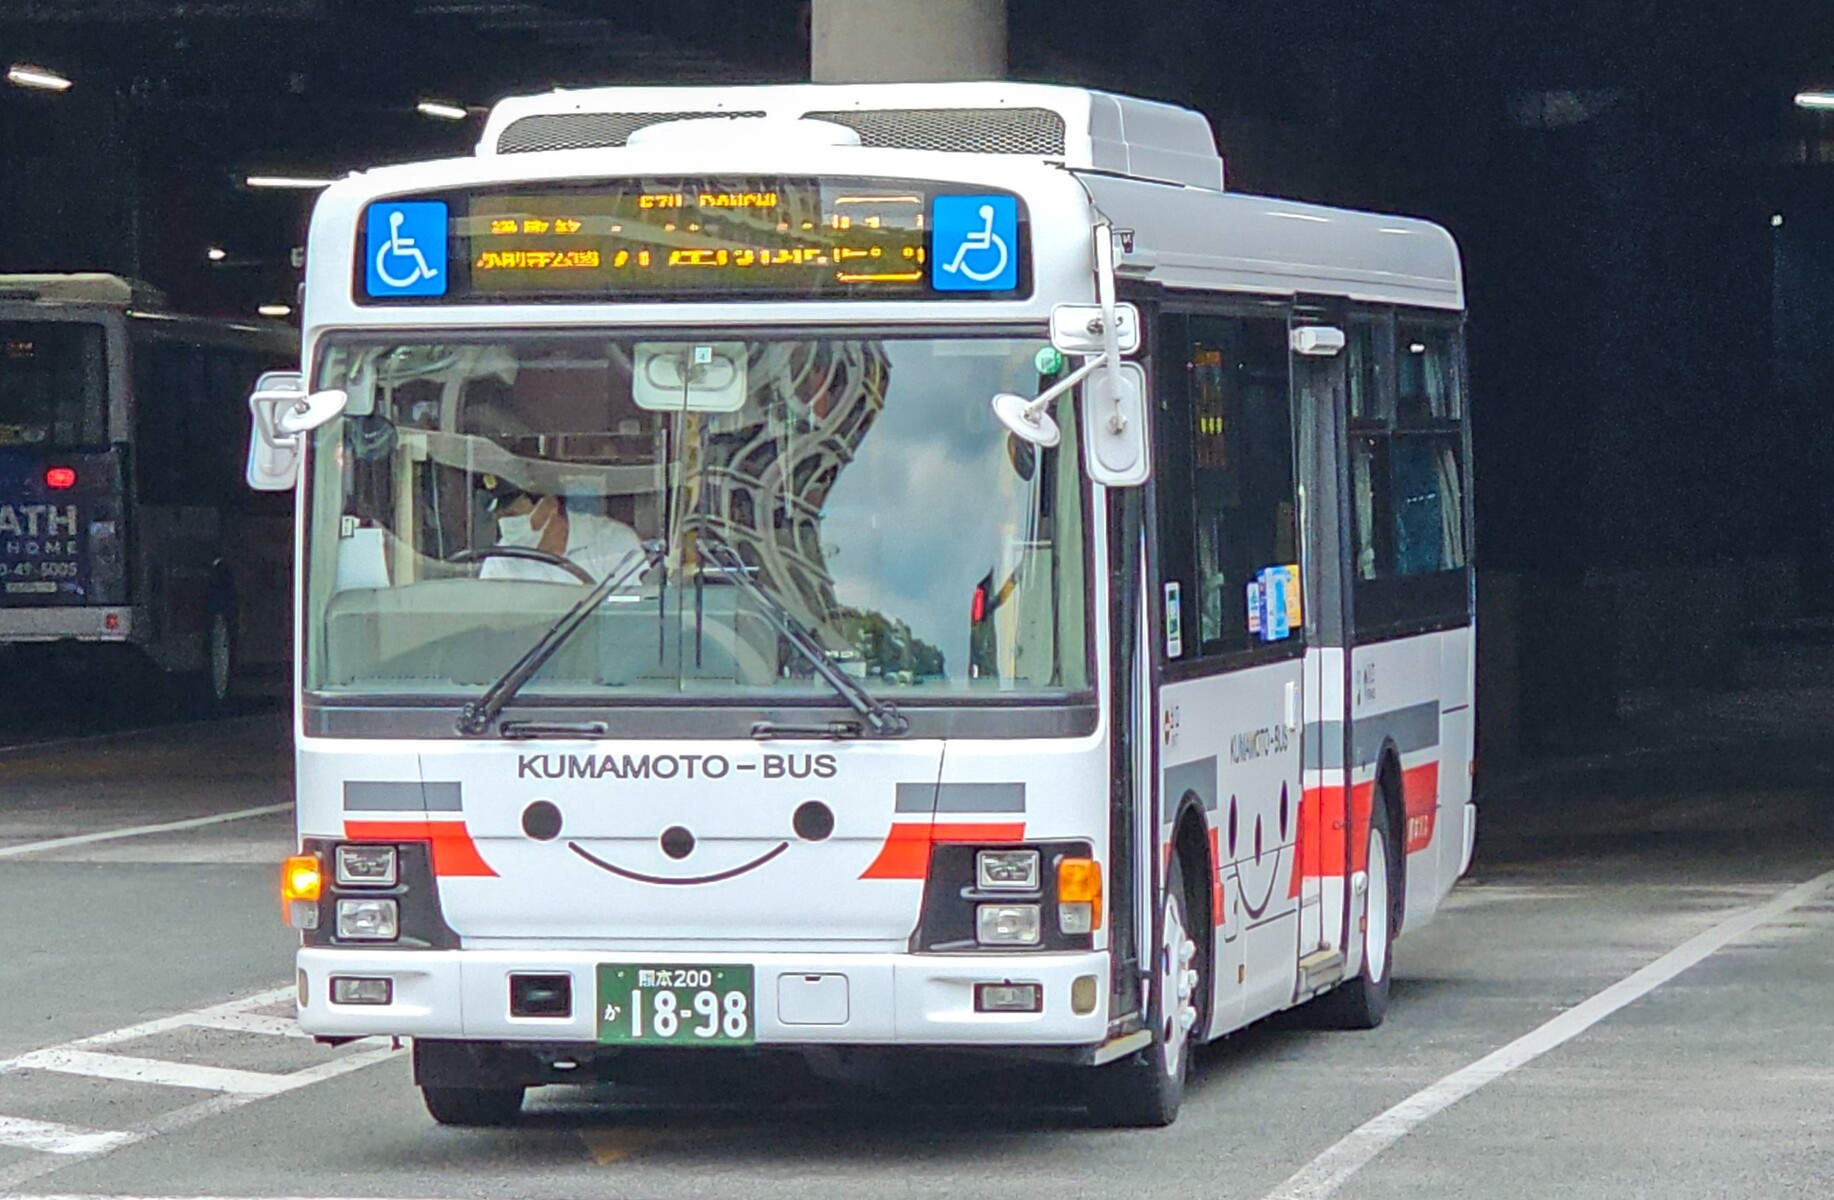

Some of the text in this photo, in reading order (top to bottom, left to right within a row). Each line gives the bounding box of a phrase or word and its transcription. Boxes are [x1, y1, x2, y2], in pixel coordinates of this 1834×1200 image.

[6, 540, 78, 555] HOME
[604, 989, 748, 1038] か 18-98
